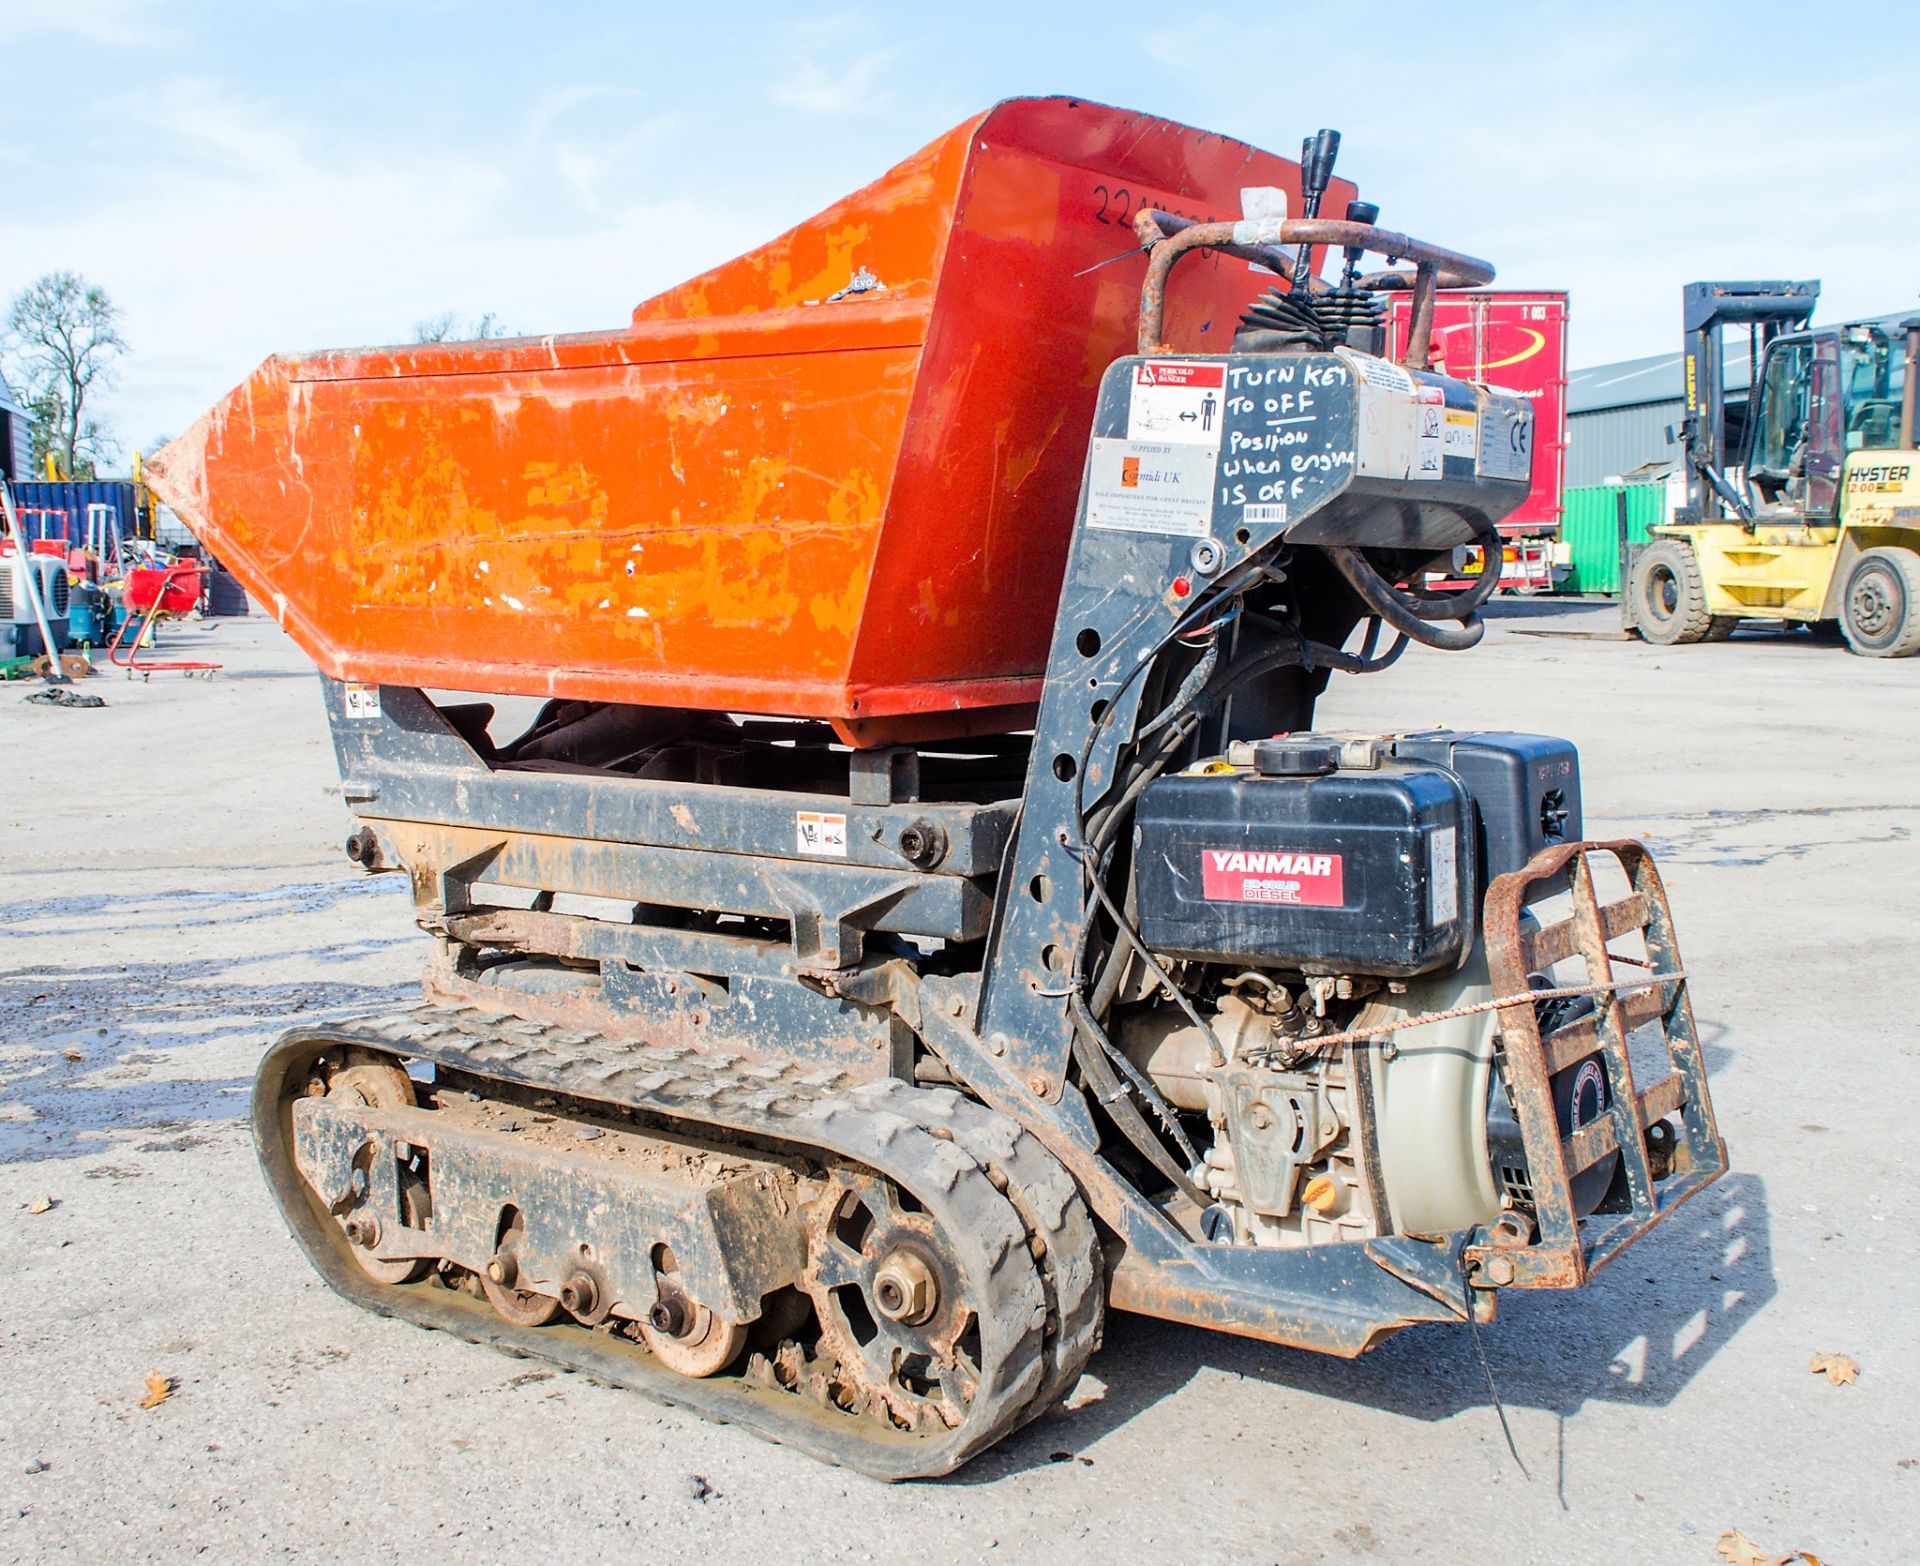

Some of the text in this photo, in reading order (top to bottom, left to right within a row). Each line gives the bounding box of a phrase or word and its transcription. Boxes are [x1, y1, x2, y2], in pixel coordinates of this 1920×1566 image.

[1159, 367, 1194, 375] PERICOLO
[1158, 375, 1187, 383] DANGER
[1687, 354, 1696, 410] HYSTER
[1264, 390, 1314, 413] OFF
[1131, 444, 1172, 454] SUPPLIED BY
[1163, 472, 1181, 483] UK
[1848, 465, 1910, 482] HYSTER
[1258, 477, 1304, 501] OFF
[1212, 852, 1332, 876] YANMAR
[1244, 889, 1301, 901] DIESEL
